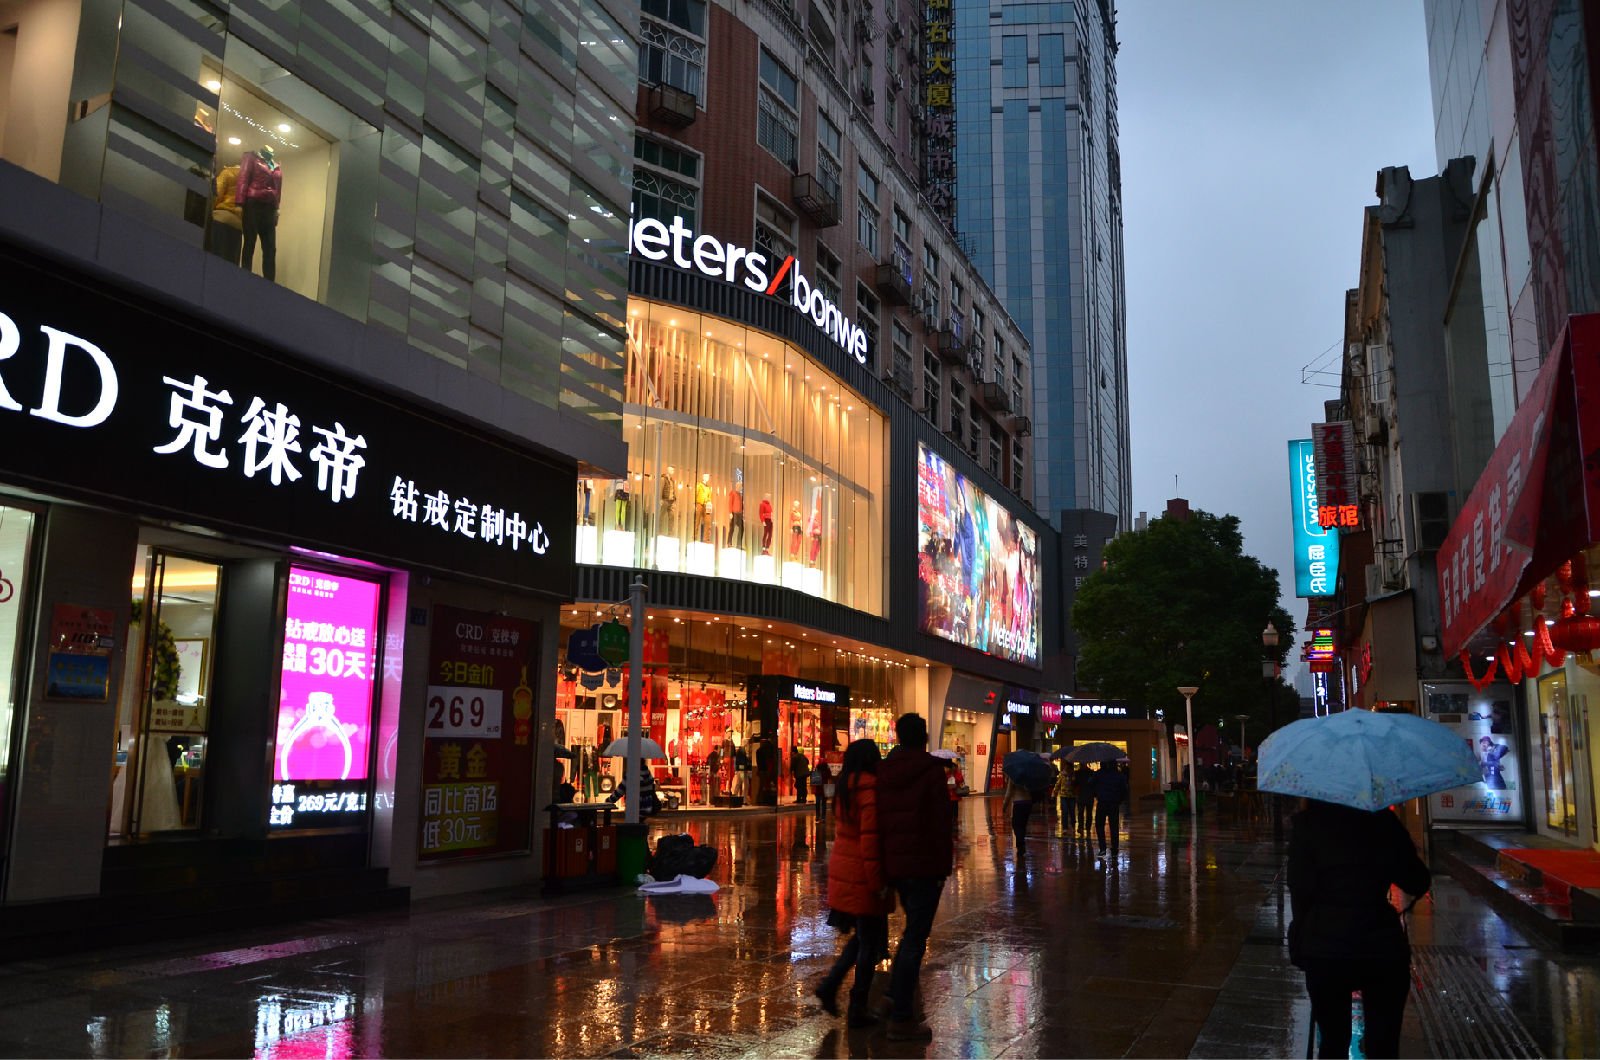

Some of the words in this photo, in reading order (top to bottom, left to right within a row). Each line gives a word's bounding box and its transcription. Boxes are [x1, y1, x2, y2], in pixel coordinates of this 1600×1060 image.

[629, 204, 868, 364] eters/bonwe
[0, 311, 119, 428] D
[153, 374, 368, 503] 克徕帝
[389, 475, 550, 554] 钻戒定制中心
[1318, 504, 1359, 527] 旅馆
[289, 574, 310, 586] CRD
[1308, 544, 1326, 593] 屈臣氏
[455, 622, 483, 641] CRD
[309, 647, 366, 680] 30天
[439, 661, 495, 686] 今日金价
[428, 695, 485, 729] 269
[437, 743, 488, 780] 黄金
[297, 792, 360, 813] 269元/克
[424, 784, 497, 817] 同比商场
[423, 817, 482, 849] 低30元
